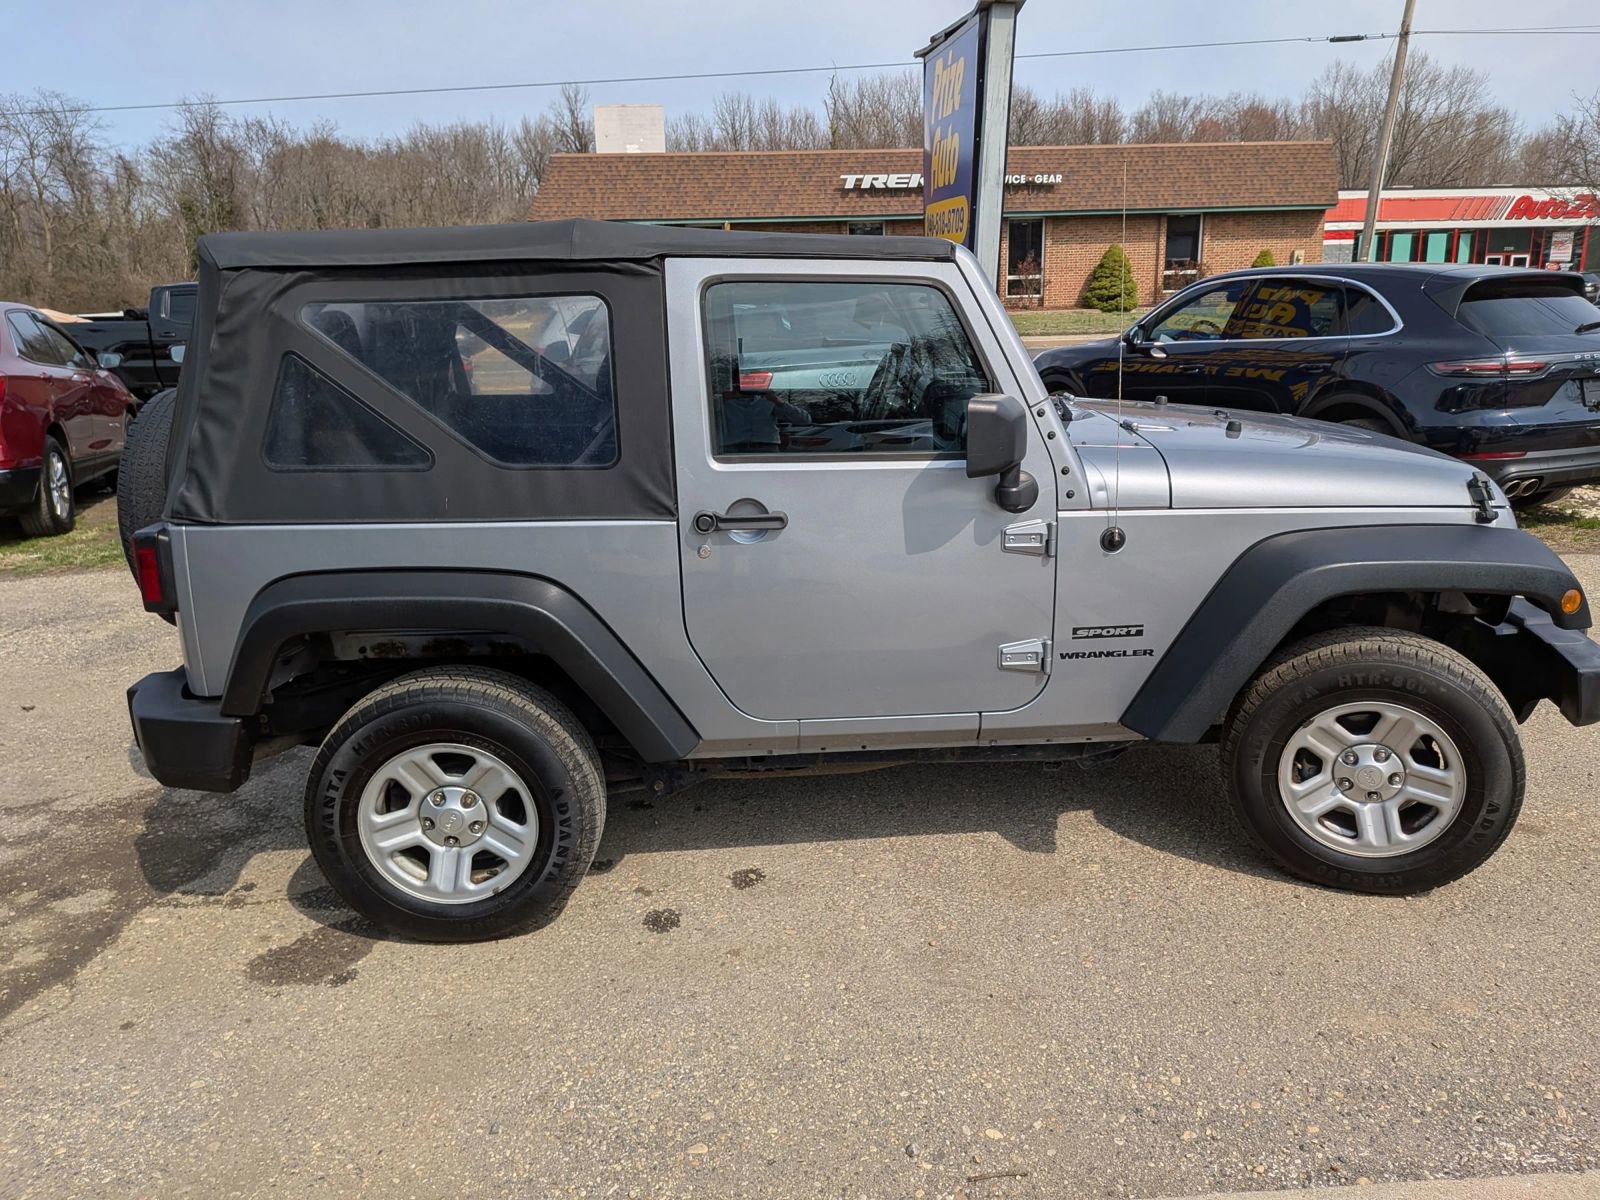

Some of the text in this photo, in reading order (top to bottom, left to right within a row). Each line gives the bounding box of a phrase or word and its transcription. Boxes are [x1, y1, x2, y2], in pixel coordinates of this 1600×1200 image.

[931, 50, 965, 124] Prize
[930, 123, 959, 198] Auto
[1034, 174, 1063, 184] GEAR
[1072, 626, 1143, 638] SPORT
[1059, 649, 1154, 660] WRANGLER
